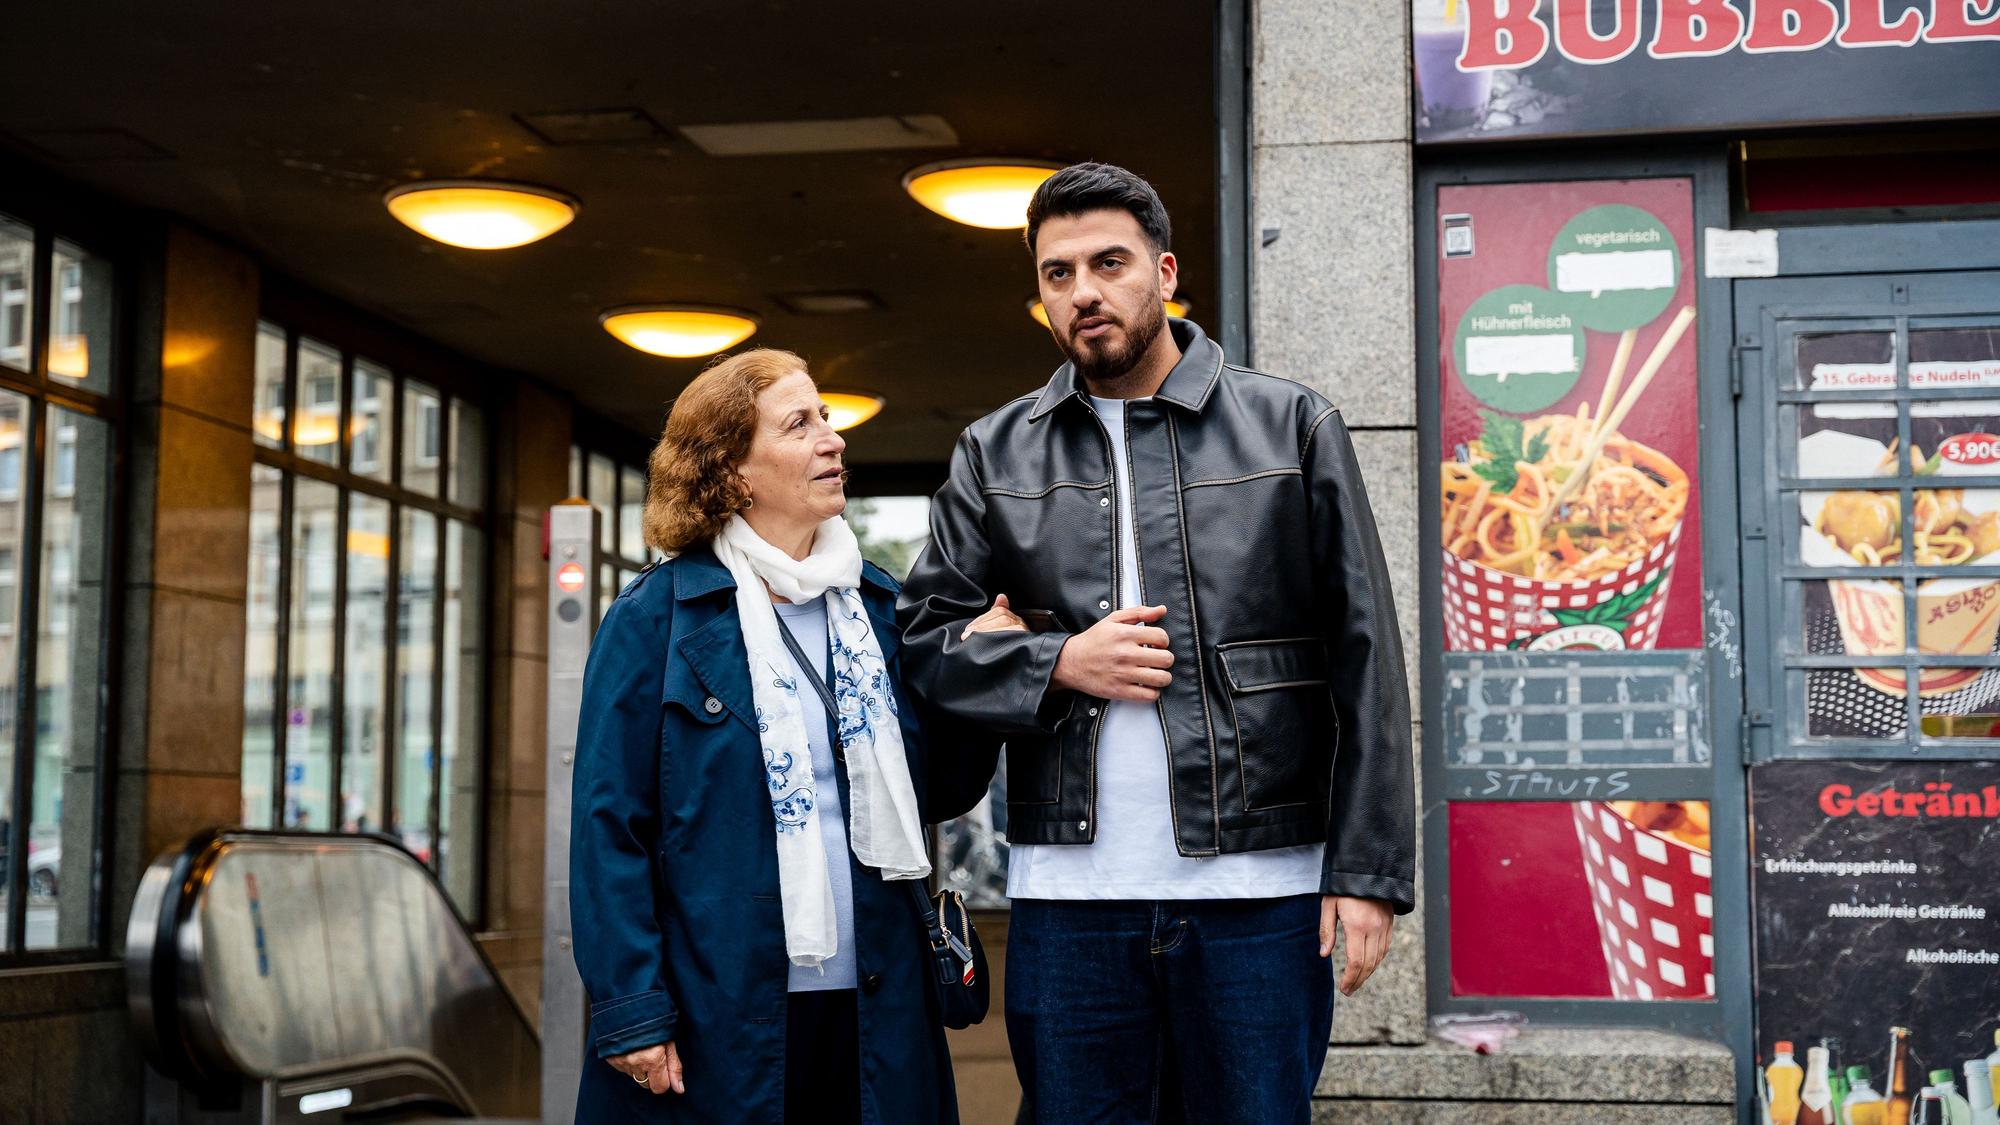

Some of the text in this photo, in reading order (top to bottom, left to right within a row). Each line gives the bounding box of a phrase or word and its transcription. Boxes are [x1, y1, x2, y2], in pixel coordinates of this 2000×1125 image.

[1576, 229, 1660, 247] vegetarisch
[1509, 301, 1533, 315] mit
[1471, 314, 1571, 331] Hühnerfleisch
[1823, 373, 1844, 385] 15.
[1928, 369, 1981, 383] Nudeln
[1765, 858, 1918, 877] Erfrischungsgetränke
[1828, 903, 1986, 920] Alkoholfreie Getränke
[1906, 948, 2000, 965] Alkoholische
